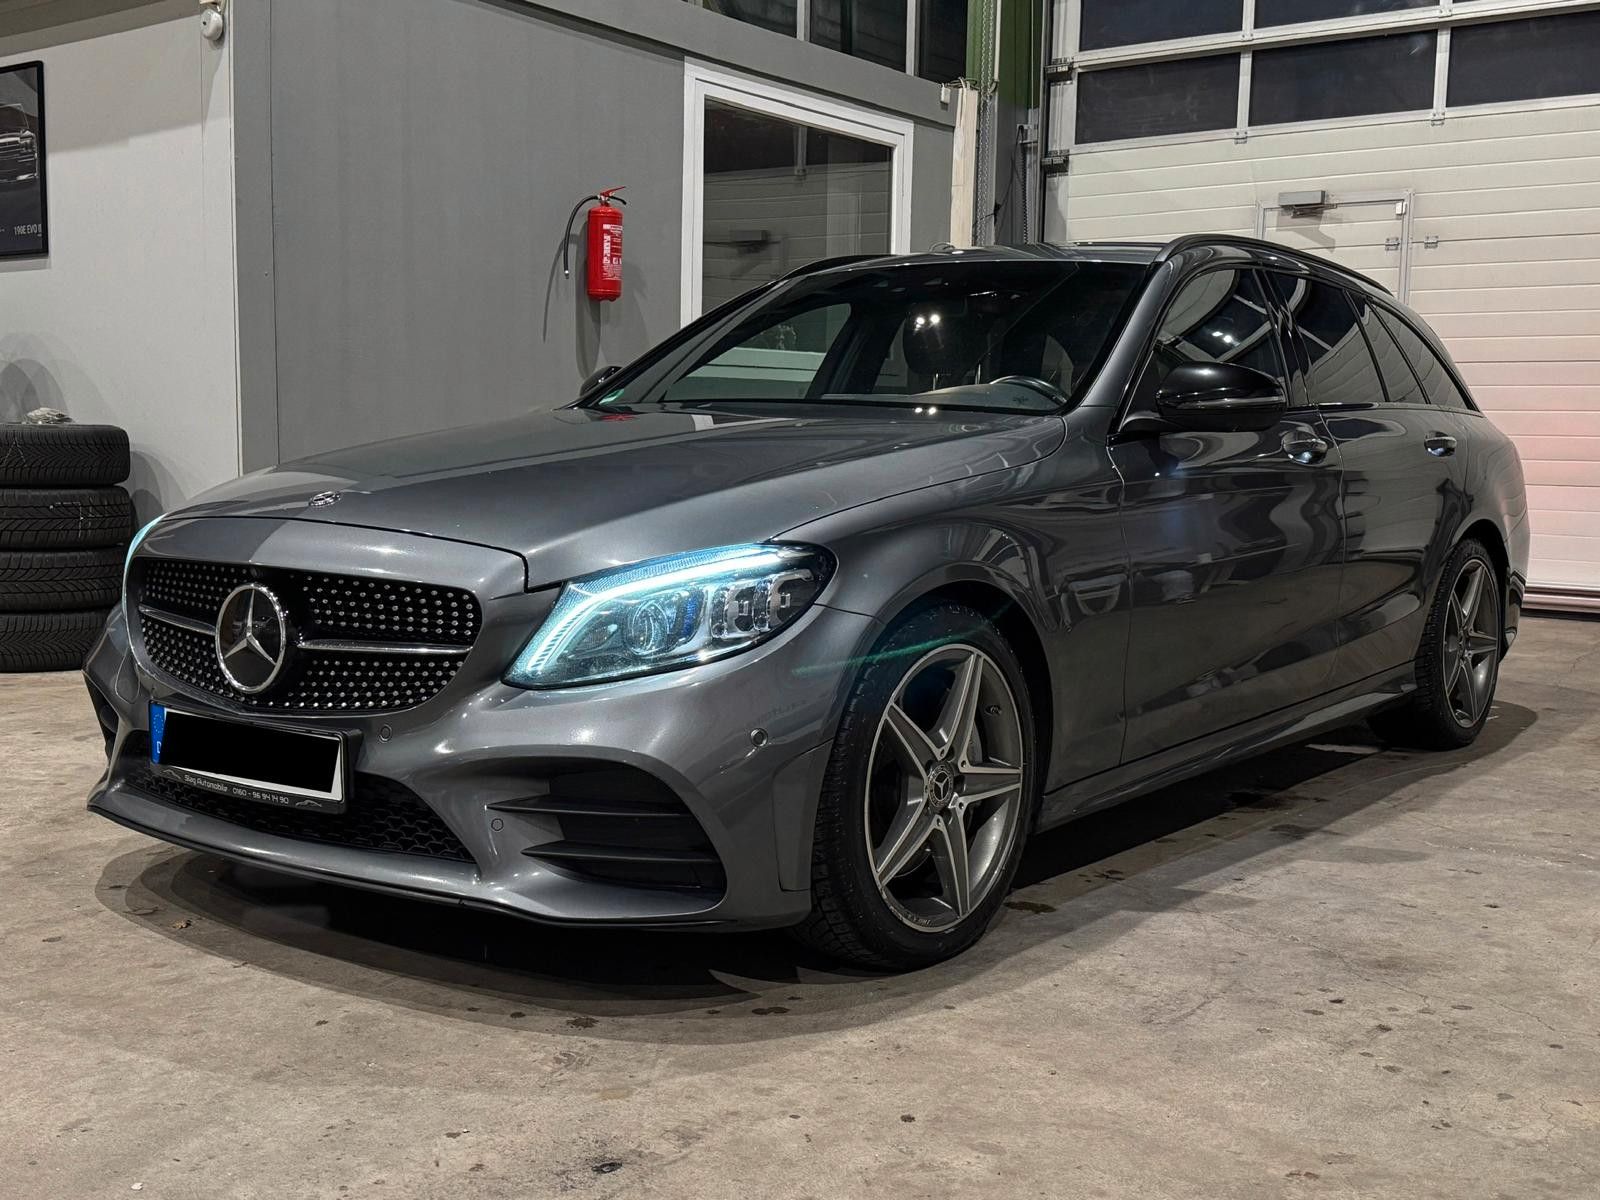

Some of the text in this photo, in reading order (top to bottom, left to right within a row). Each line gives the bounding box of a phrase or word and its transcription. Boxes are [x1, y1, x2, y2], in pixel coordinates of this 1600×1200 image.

[27, 223, 37, 234] EVO
[197, 778, 228, 792] Automobile
[232, 787, 247, 796] 0160
